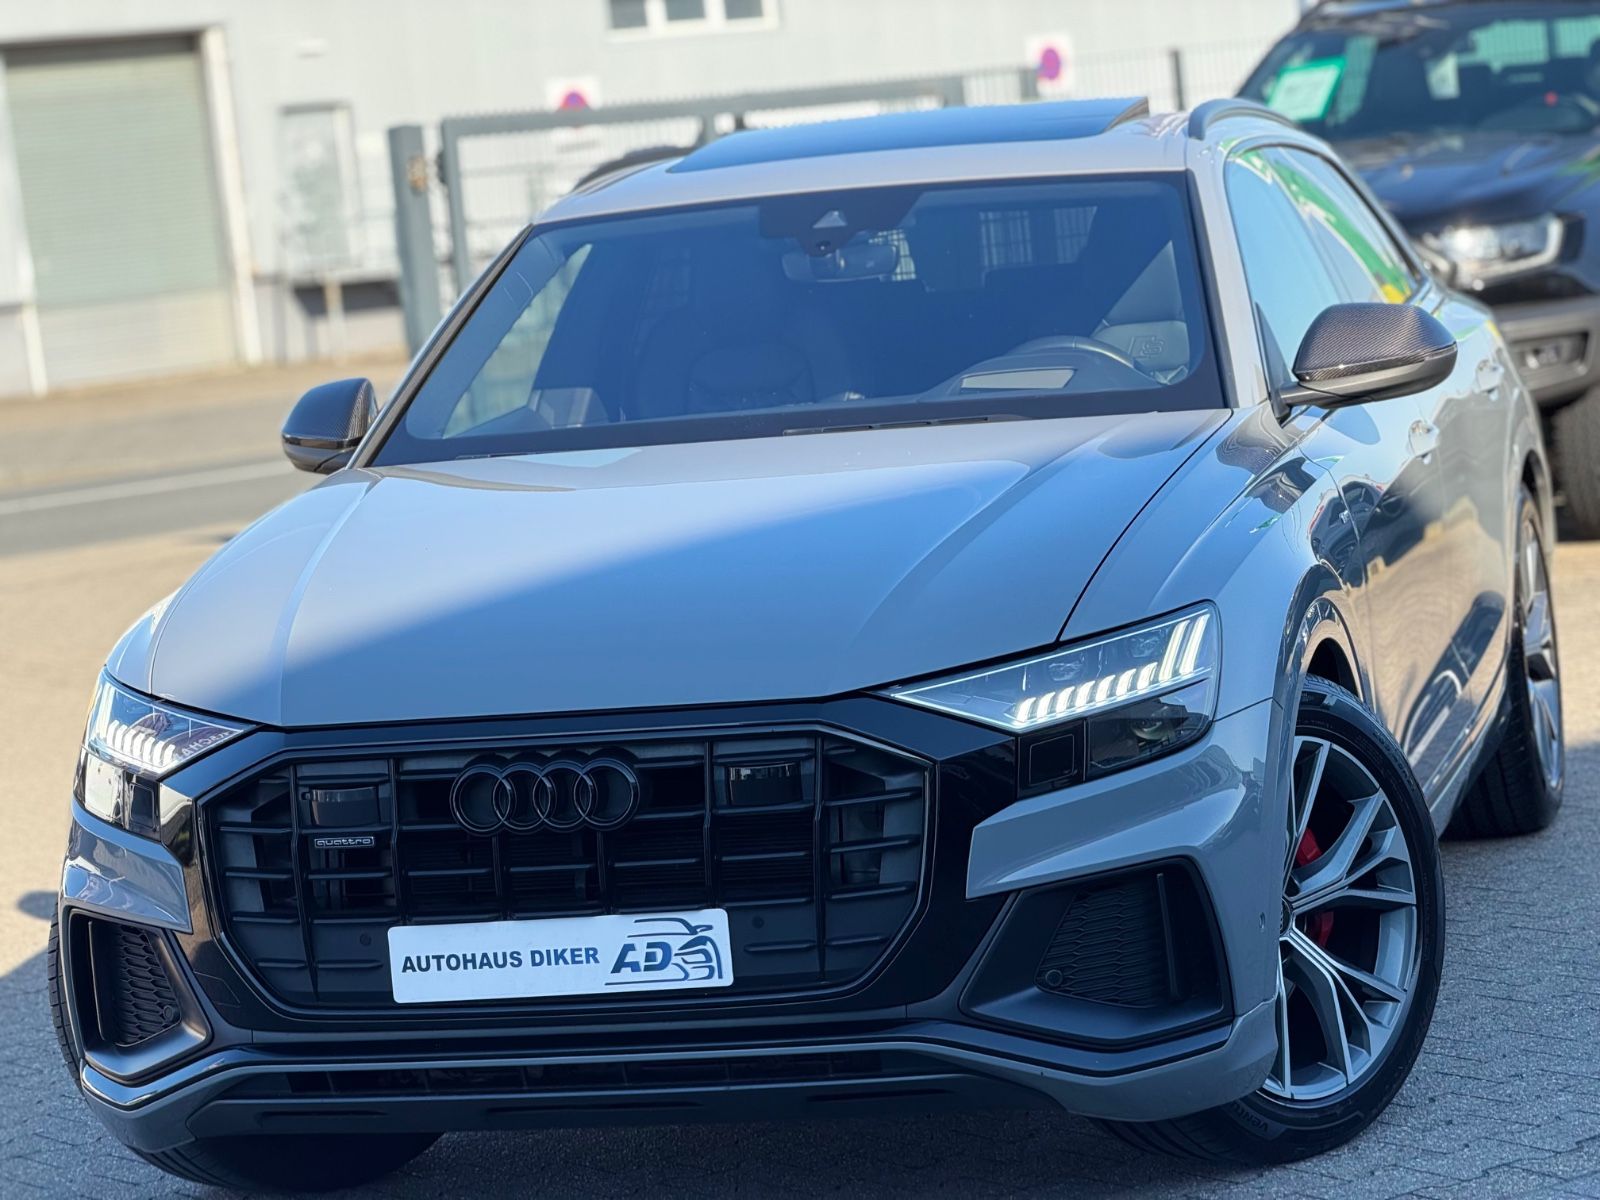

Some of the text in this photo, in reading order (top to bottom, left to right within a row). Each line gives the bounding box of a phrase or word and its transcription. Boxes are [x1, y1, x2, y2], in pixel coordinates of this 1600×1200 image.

[317, 838, 371, 847] quattro
[402, 947, 600, 973] AUTOHAUS DIKER
